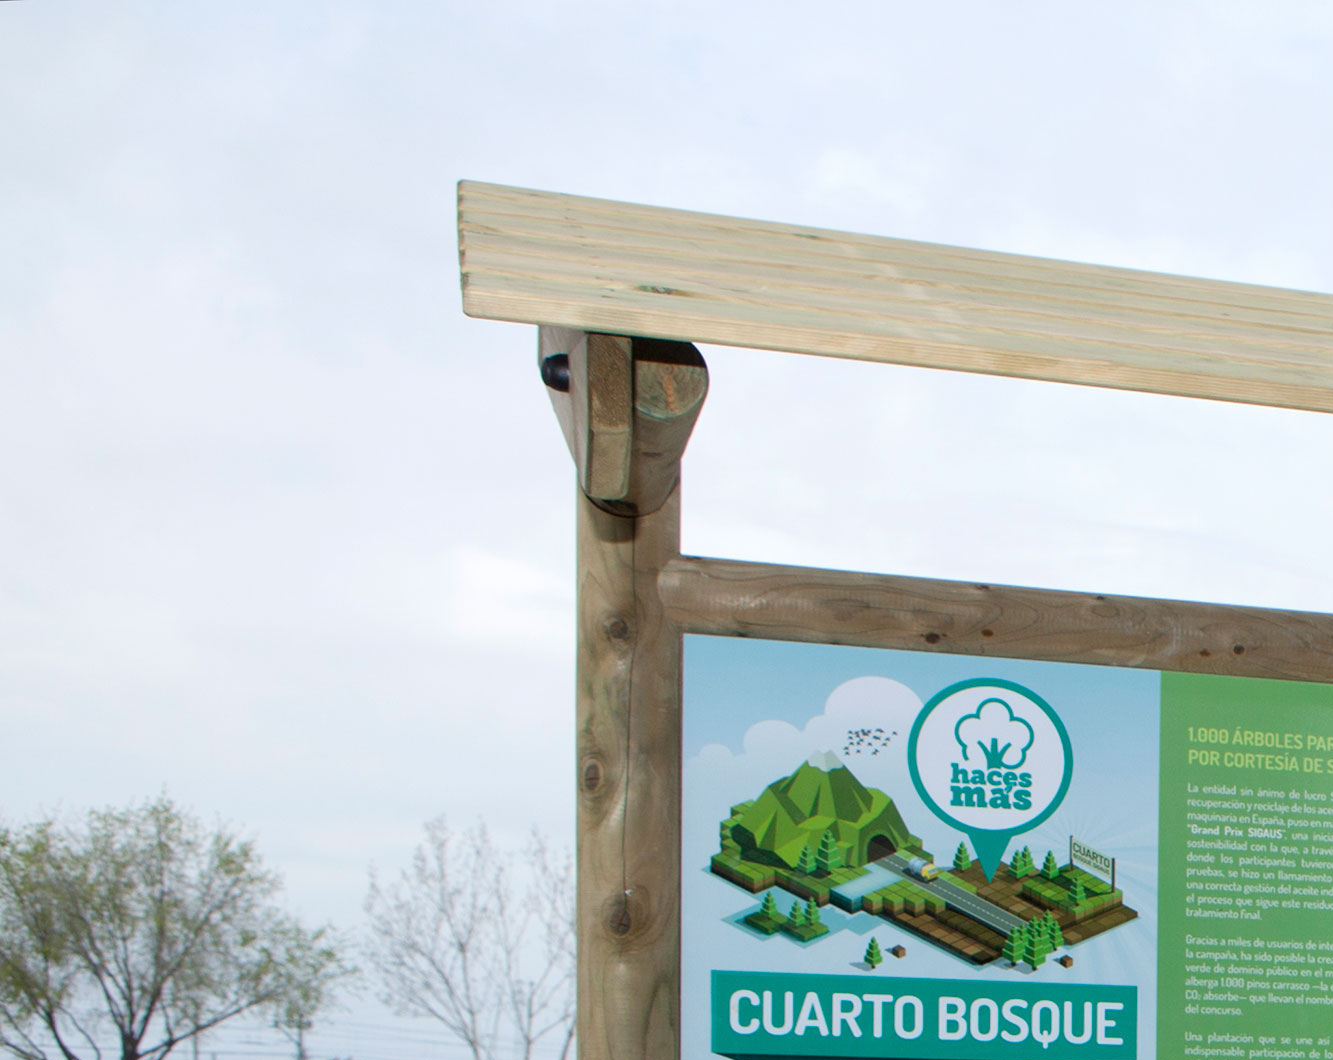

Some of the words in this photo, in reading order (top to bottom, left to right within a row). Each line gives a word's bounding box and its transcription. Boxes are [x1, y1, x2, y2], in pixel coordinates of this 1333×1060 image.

[1188, 726, 1229, 744] 1.000
[1231, 727, 1303, 749] ÁRBOLES
[1187, 748, 1219, 765] POR
[1223, 751, 1299, 771] CORTESÍA
[1302, 756, 1323, 773] DE
[950, 762, 1032, 788] haces
[950, 784, 1032, 810] más
[1072, 843, 1110, 868] CUARTO
[1186, 851, 1215, 863] donde
[1220, 852, 1233, 863] los
[1238, 855, 1296, 867] participantes
[729, 989, 924, 1040] CUARTO
[938, 996, 1124, 1049] BOSQUE
